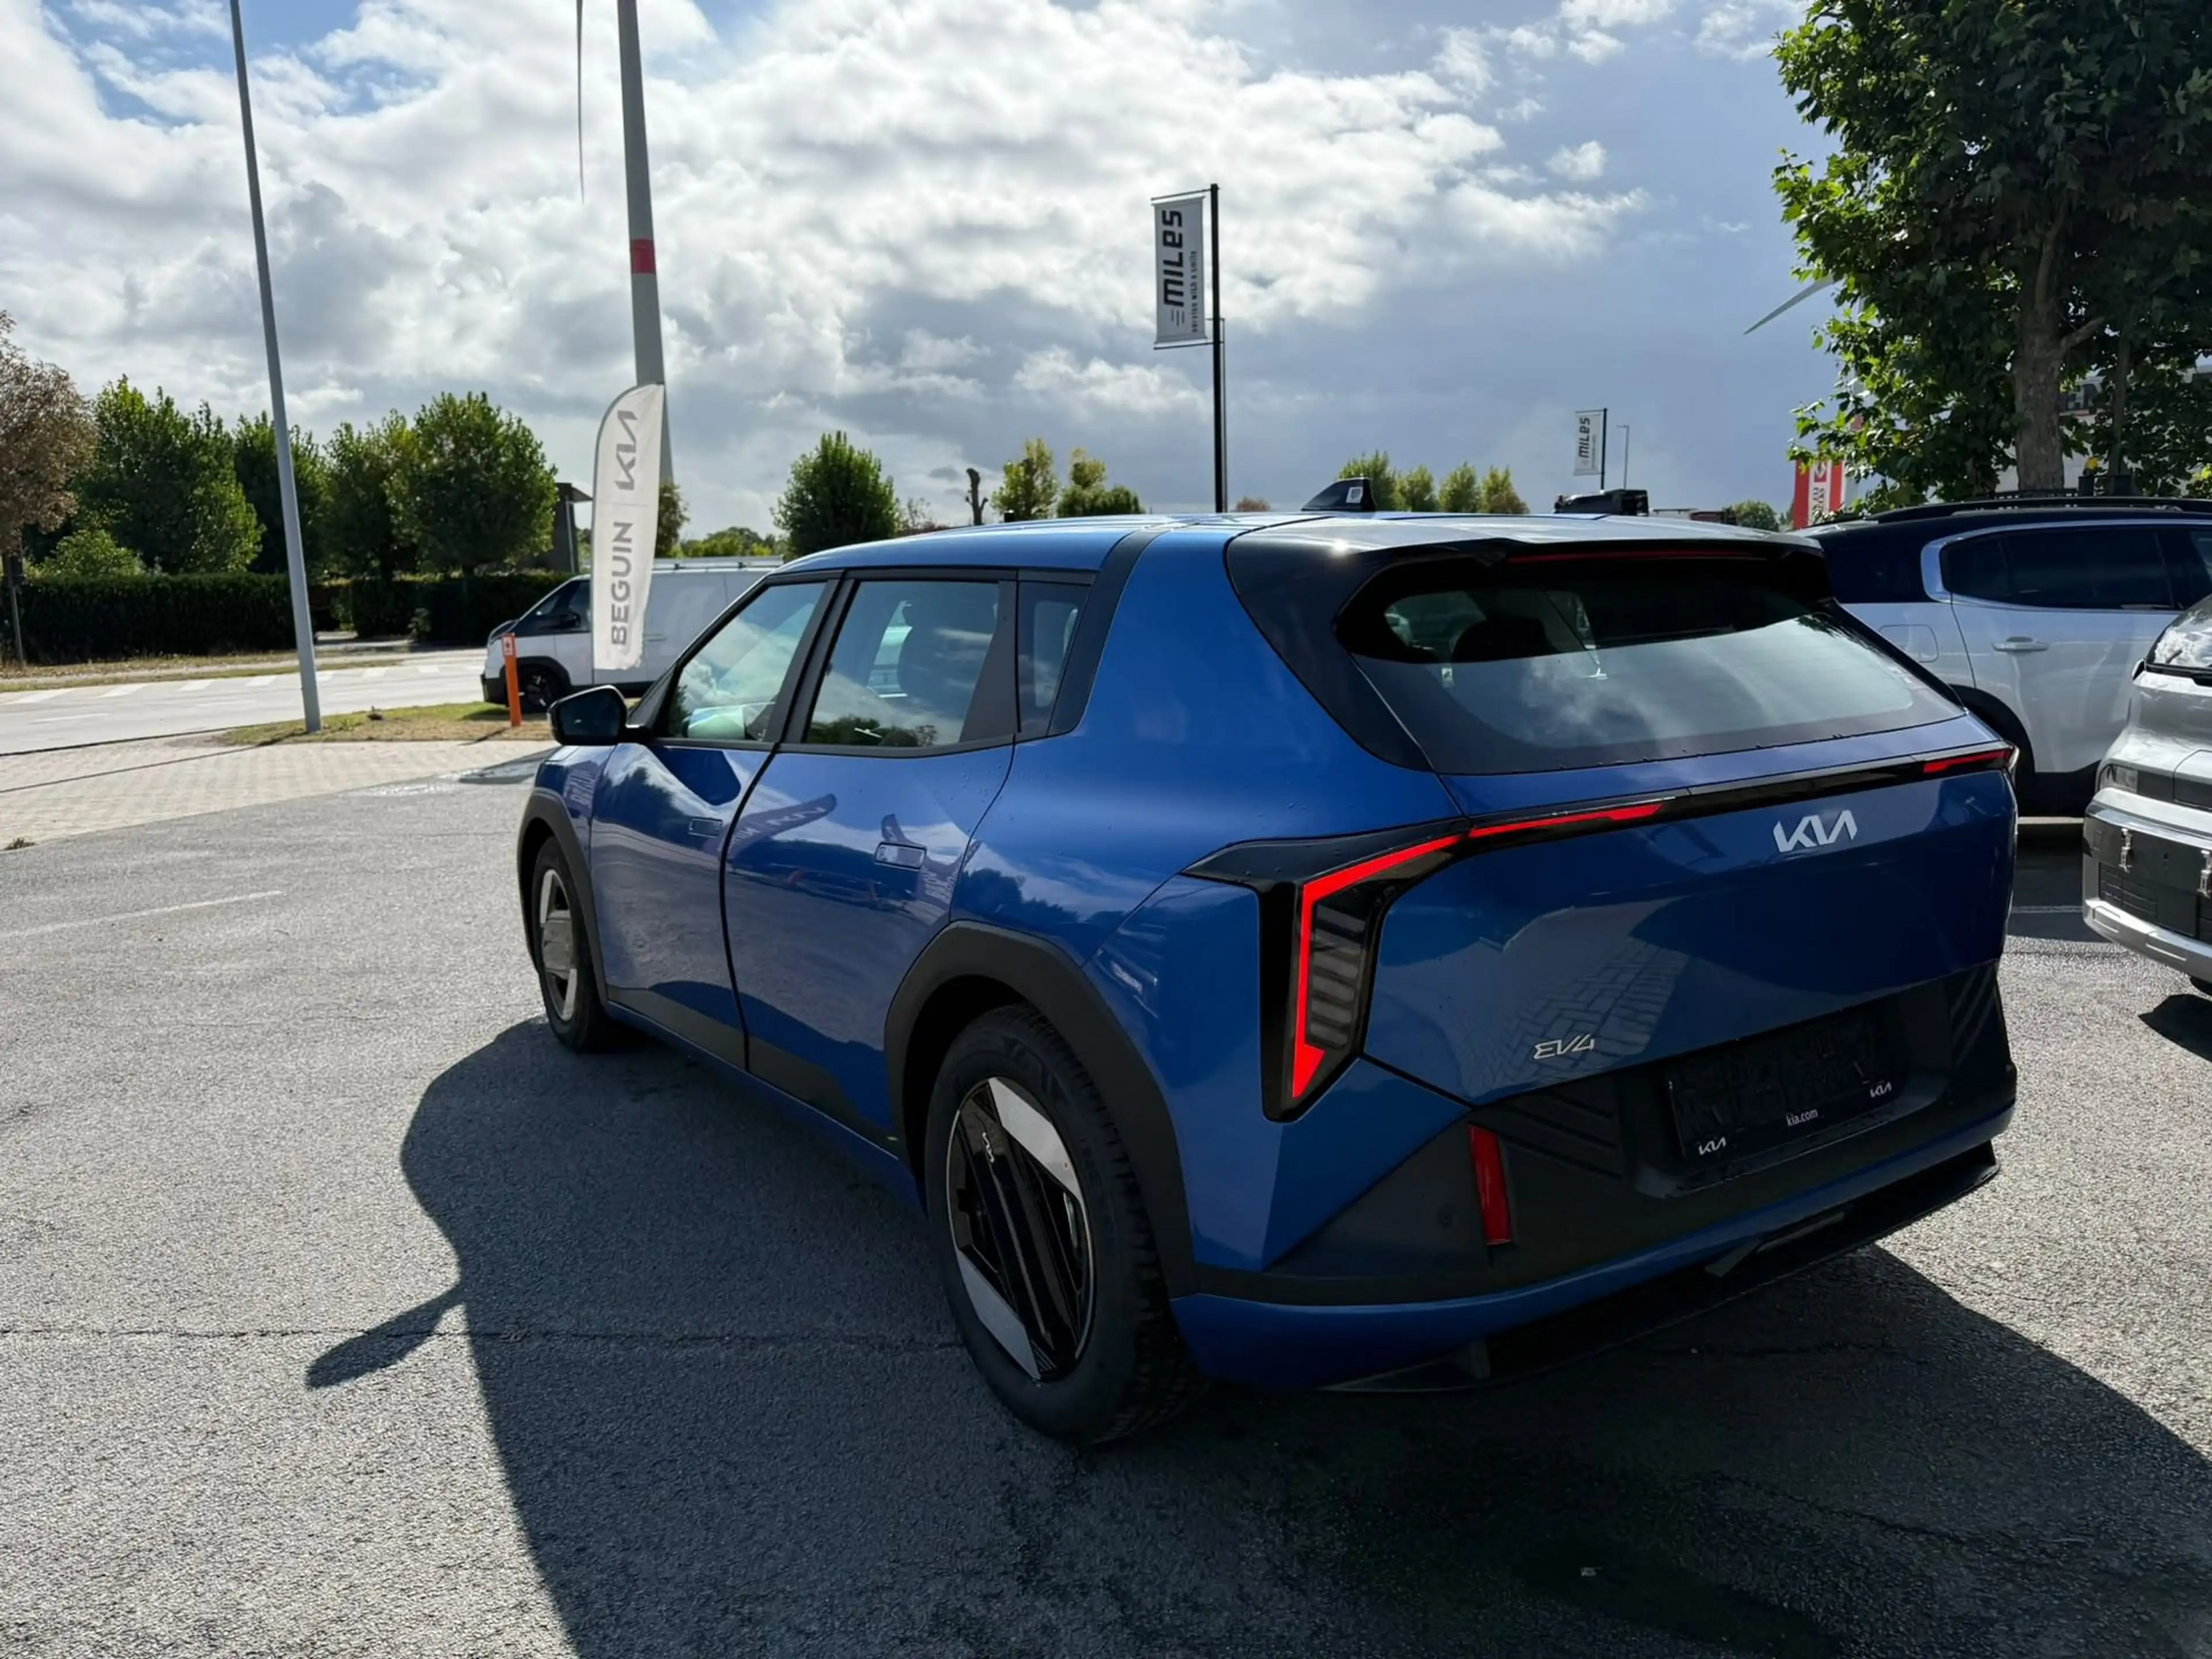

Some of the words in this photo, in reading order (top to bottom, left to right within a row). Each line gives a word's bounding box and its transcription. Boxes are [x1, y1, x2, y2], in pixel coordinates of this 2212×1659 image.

[615, 410, 638, 491] KIA
[611, 522, 633, 645] BEGUIN
[1773, 809, 1857, 853] KIA
[1533, 1033, 1594, 1060] EV4
[1870, 1082, 1892, 1097] KIA
[1786, 1108, 1818, 1127] kia.com
[1698, 1137, 1727, 1156] KIA
